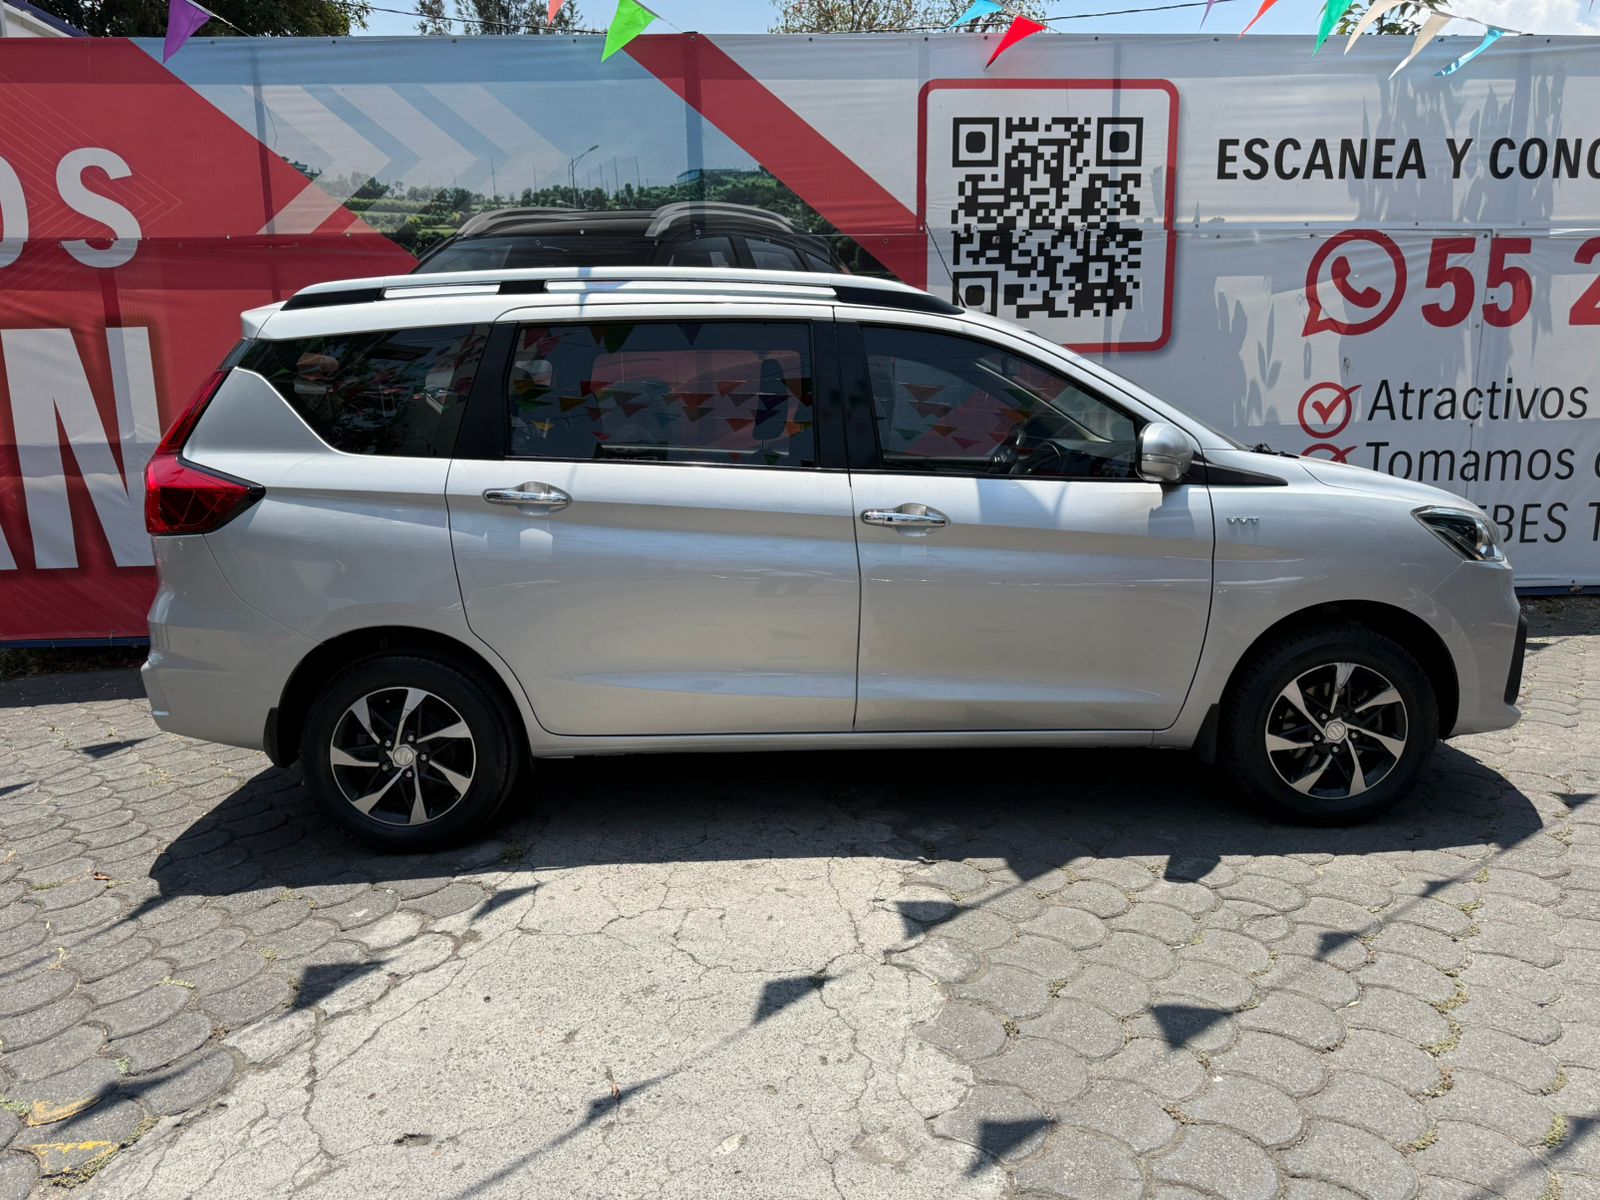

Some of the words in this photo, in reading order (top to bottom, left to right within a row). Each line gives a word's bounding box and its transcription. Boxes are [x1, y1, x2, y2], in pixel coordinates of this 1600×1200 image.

[1217, 137, 1427, 180] ESCANEA
[1446, 138, 1474, 179] Y
[1421, 237, 1533, 328] 55
[1367, 377, 1589, 421] Atractivos
[1366, 441, 1575, 482] Tomamos
